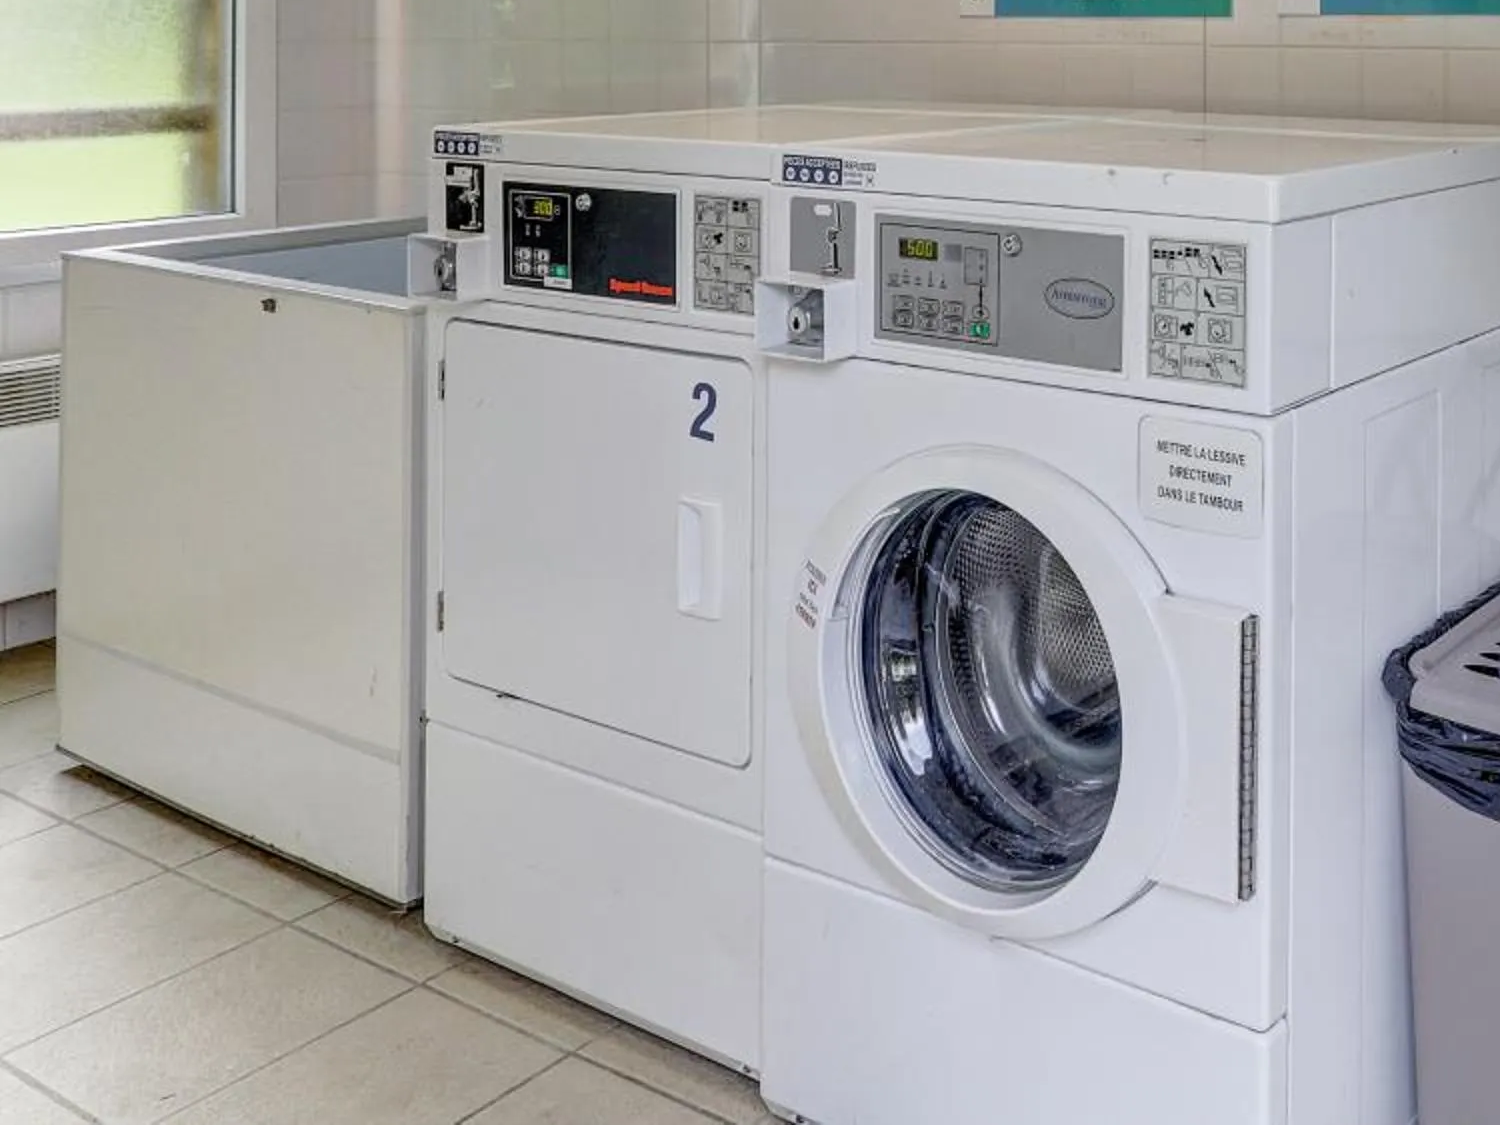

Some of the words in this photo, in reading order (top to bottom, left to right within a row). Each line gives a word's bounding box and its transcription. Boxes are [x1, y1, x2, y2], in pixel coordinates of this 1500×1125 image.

[690, 382, 717, 442] 2
[1157, 440, 1193, 458] METTRE
[1194, 447, 1207, 460] LA
[1207, 449, 1246, 467] LESSIVE
[1169, 464, 1232, 488] DIRECTEMENT
[1157, 485, 1182, 502] DANS
[1185, 490, 1197, 504] LE
[1199, 492, 1244, 512] TAMBOUR
